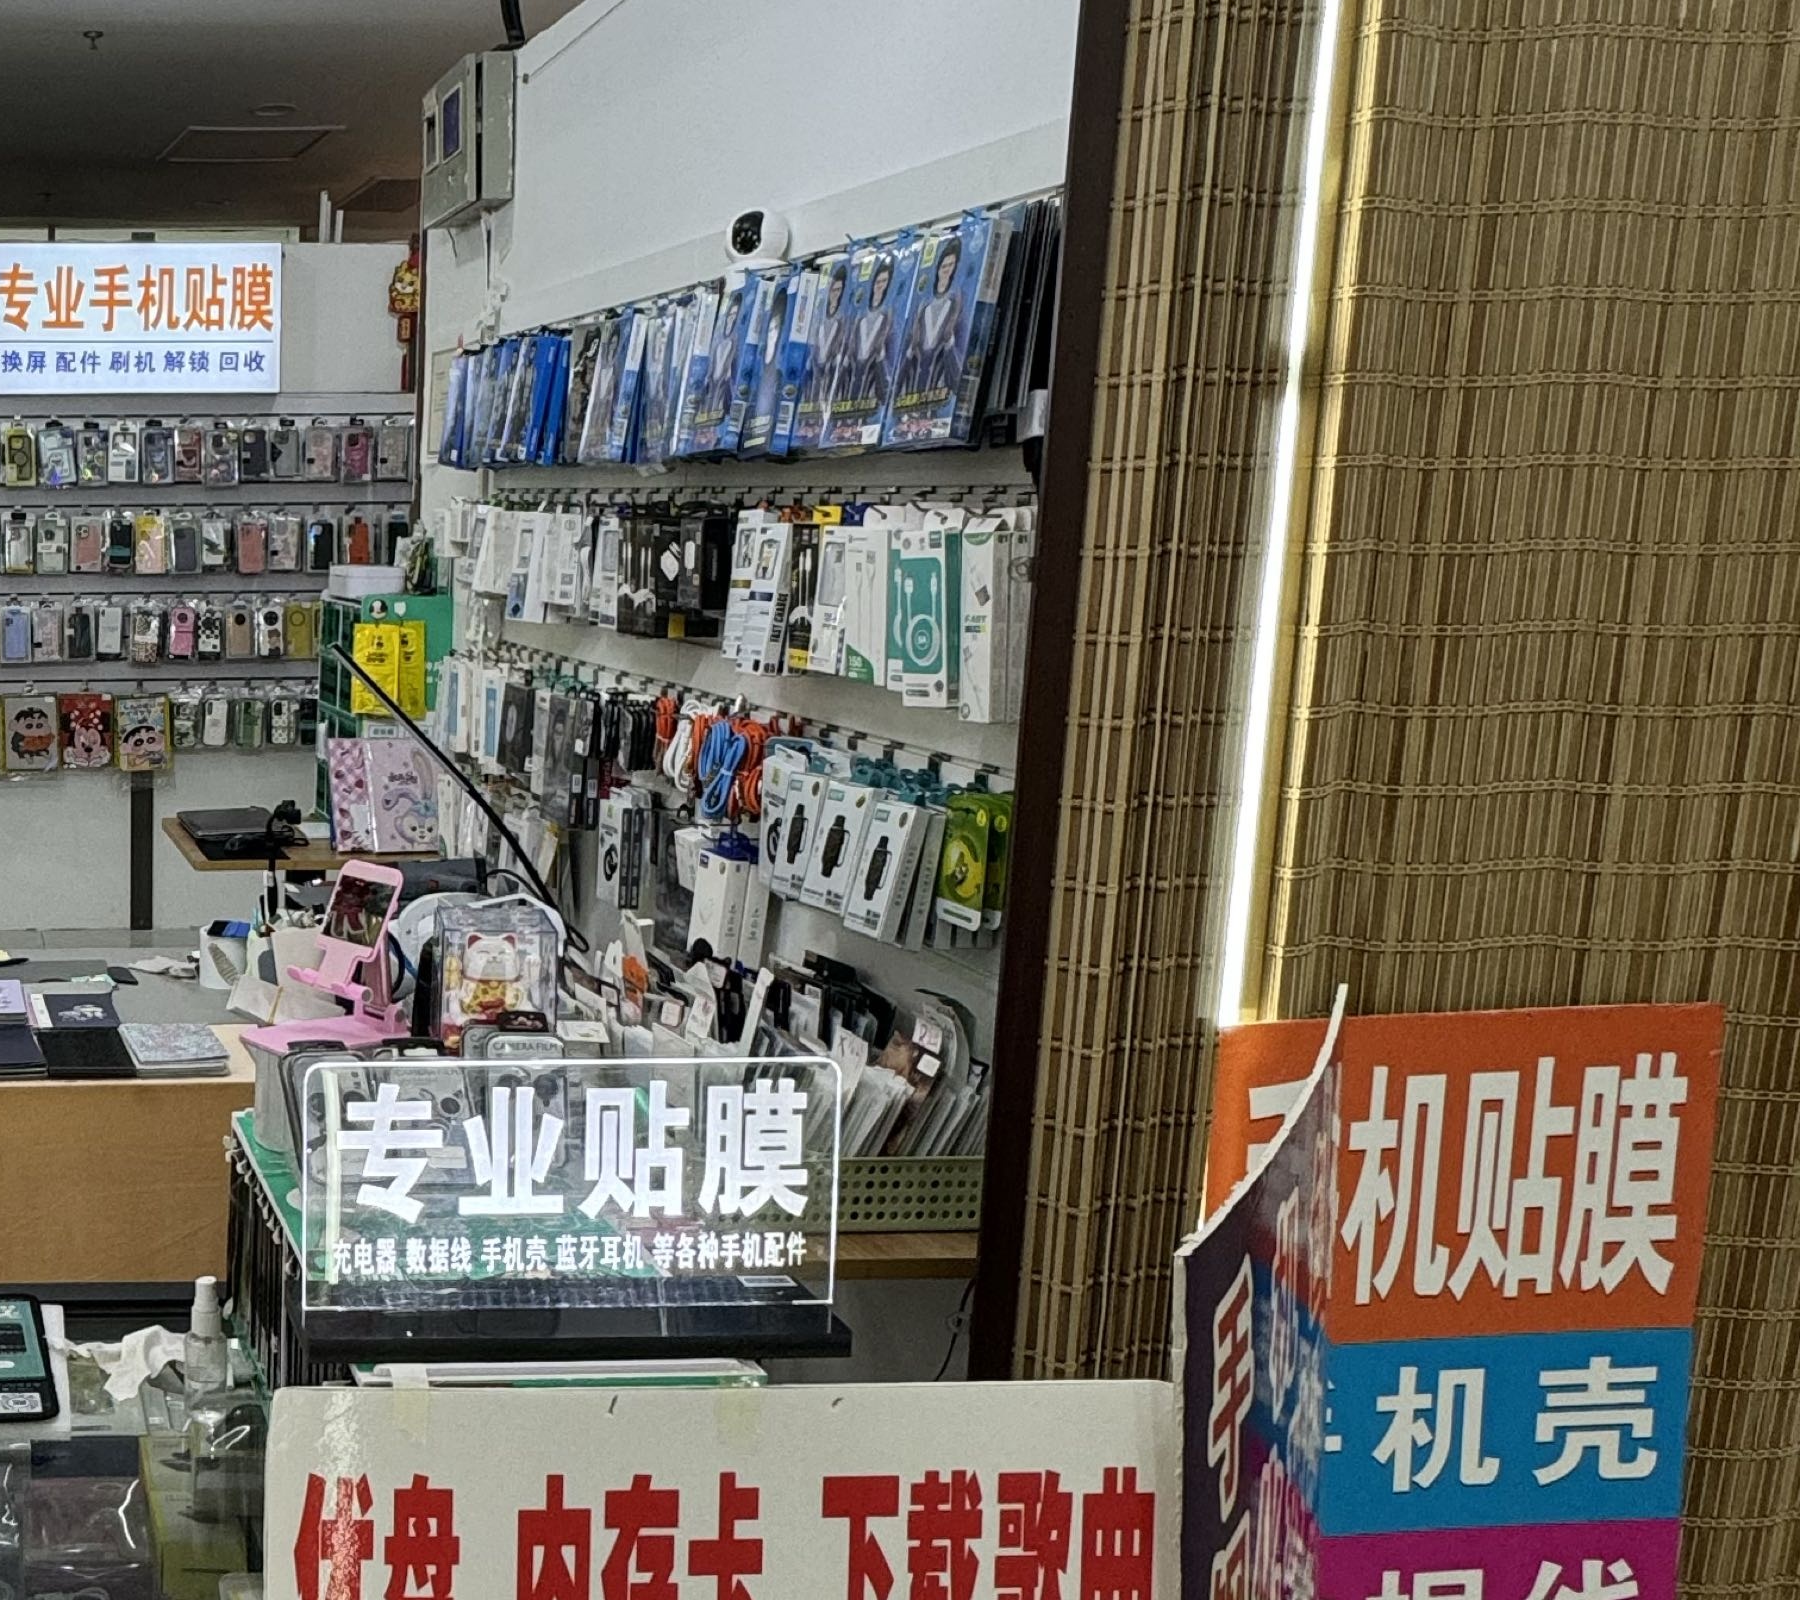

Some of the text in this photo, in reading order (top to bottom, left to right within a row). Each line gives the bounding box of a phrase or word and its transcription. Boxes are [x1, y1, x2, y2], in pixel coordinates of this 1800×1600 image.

[1, 351, 265, 373] 换屏 配件 刷机 解锁 回收
[336, 1078, 809, 1223] 专业贴膜
[332, 1231, 808, 1275] 充电器 数据线 手机壳 蓝牙耳机 等各种手机配件
[1325, 1355, 1661, 1493] 机壳
